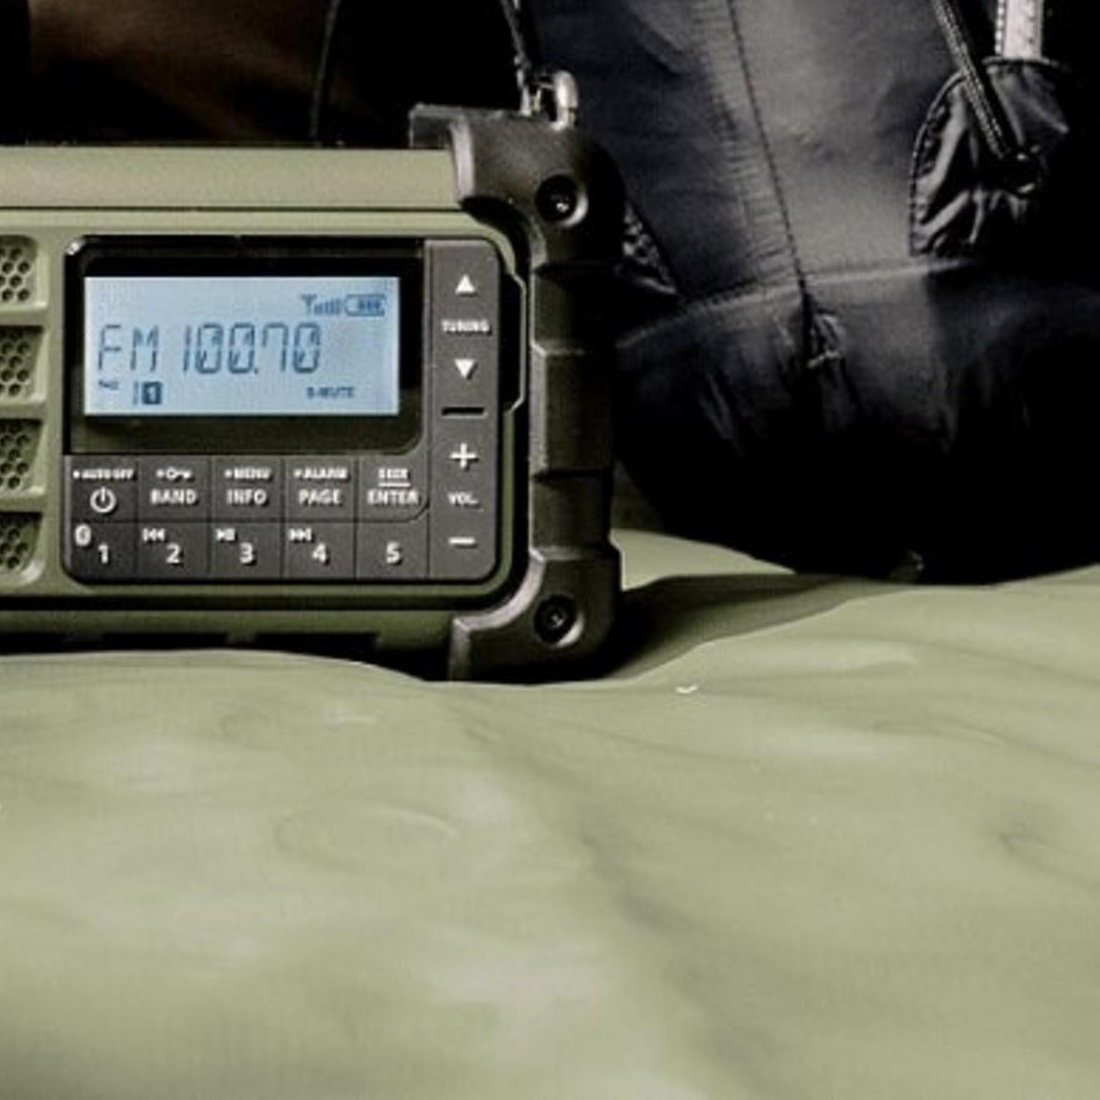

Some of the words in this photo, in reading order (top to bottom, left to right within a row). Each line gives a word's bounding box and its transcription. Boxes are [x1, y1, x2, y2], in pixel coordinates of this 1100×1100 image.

[441, 319, 491, 332] TUNING
[98, 323, 159, 372] FM
[233, 468, 272, 480] MENU
[302, 468, 349, 480] ALARM
[151, 488, 197, 505] BAND
[227, 488, 267, 505] INFO
[300, 488, 342, 505] PAGE
[367, 488, 419, 505] ENTER
[98, 543, 109, 564] 1
[166, 542, 181, 564] 2
[239, 542, 254, 564] 3
[312, 542, 328, 564] 4
[386, 542, 401, 565] 5
